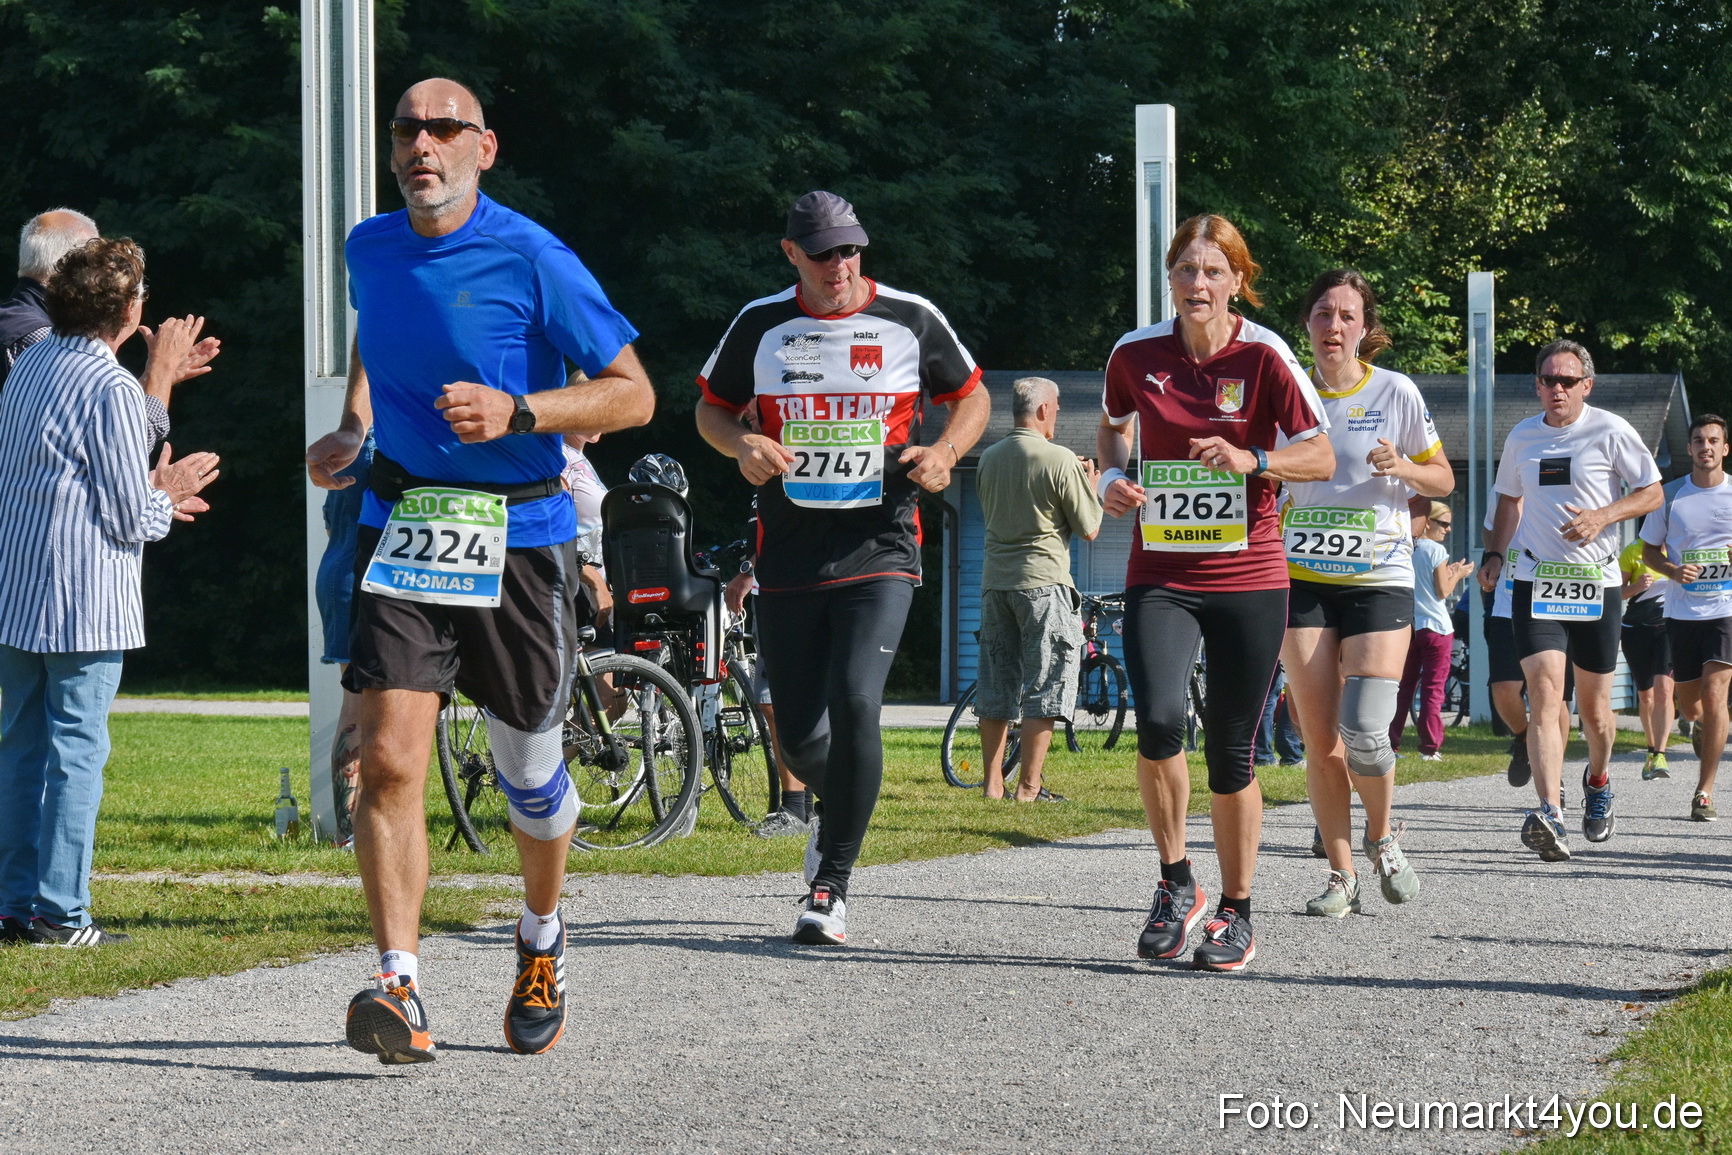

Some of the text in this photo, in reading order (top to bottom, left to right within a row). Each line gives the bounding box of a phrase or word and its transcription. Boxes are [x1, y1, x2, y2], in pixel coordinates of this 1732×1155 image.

[853, 331, 880, 340] kalas
[785, 354, 821, 362] XconCept
[1348, 407, 1365, 418] 20
[788, 421, 876, 444] BOCK
[794, 451, 872, 479] 2747
[1149, 464, 1237, 486] BOCK
[398, 493, 496, 522] BOCK
[1153, 492, 1234, 521] 1262
[1290, 509, 1369, 531] BOCK
[1163, 529, 1223, 542] SABINE
[1289, 531, 1363, 558] 2292
[389, 526, 489, 567] 2224
[1683, 550, 1728, 562] BOCK
[1295, 560, 1356, 573] CLAUDIA
[1538, 562, 1597, 578] BOCK
[1698, 565, 1729, 580] 227
[391, 569, 475, 591] THOMAS
[1694, 583, 1723, 591] JONAS
[1540, 581, 1597, 601] 2430
[1546, 602, 1589, 616] MARTIN
